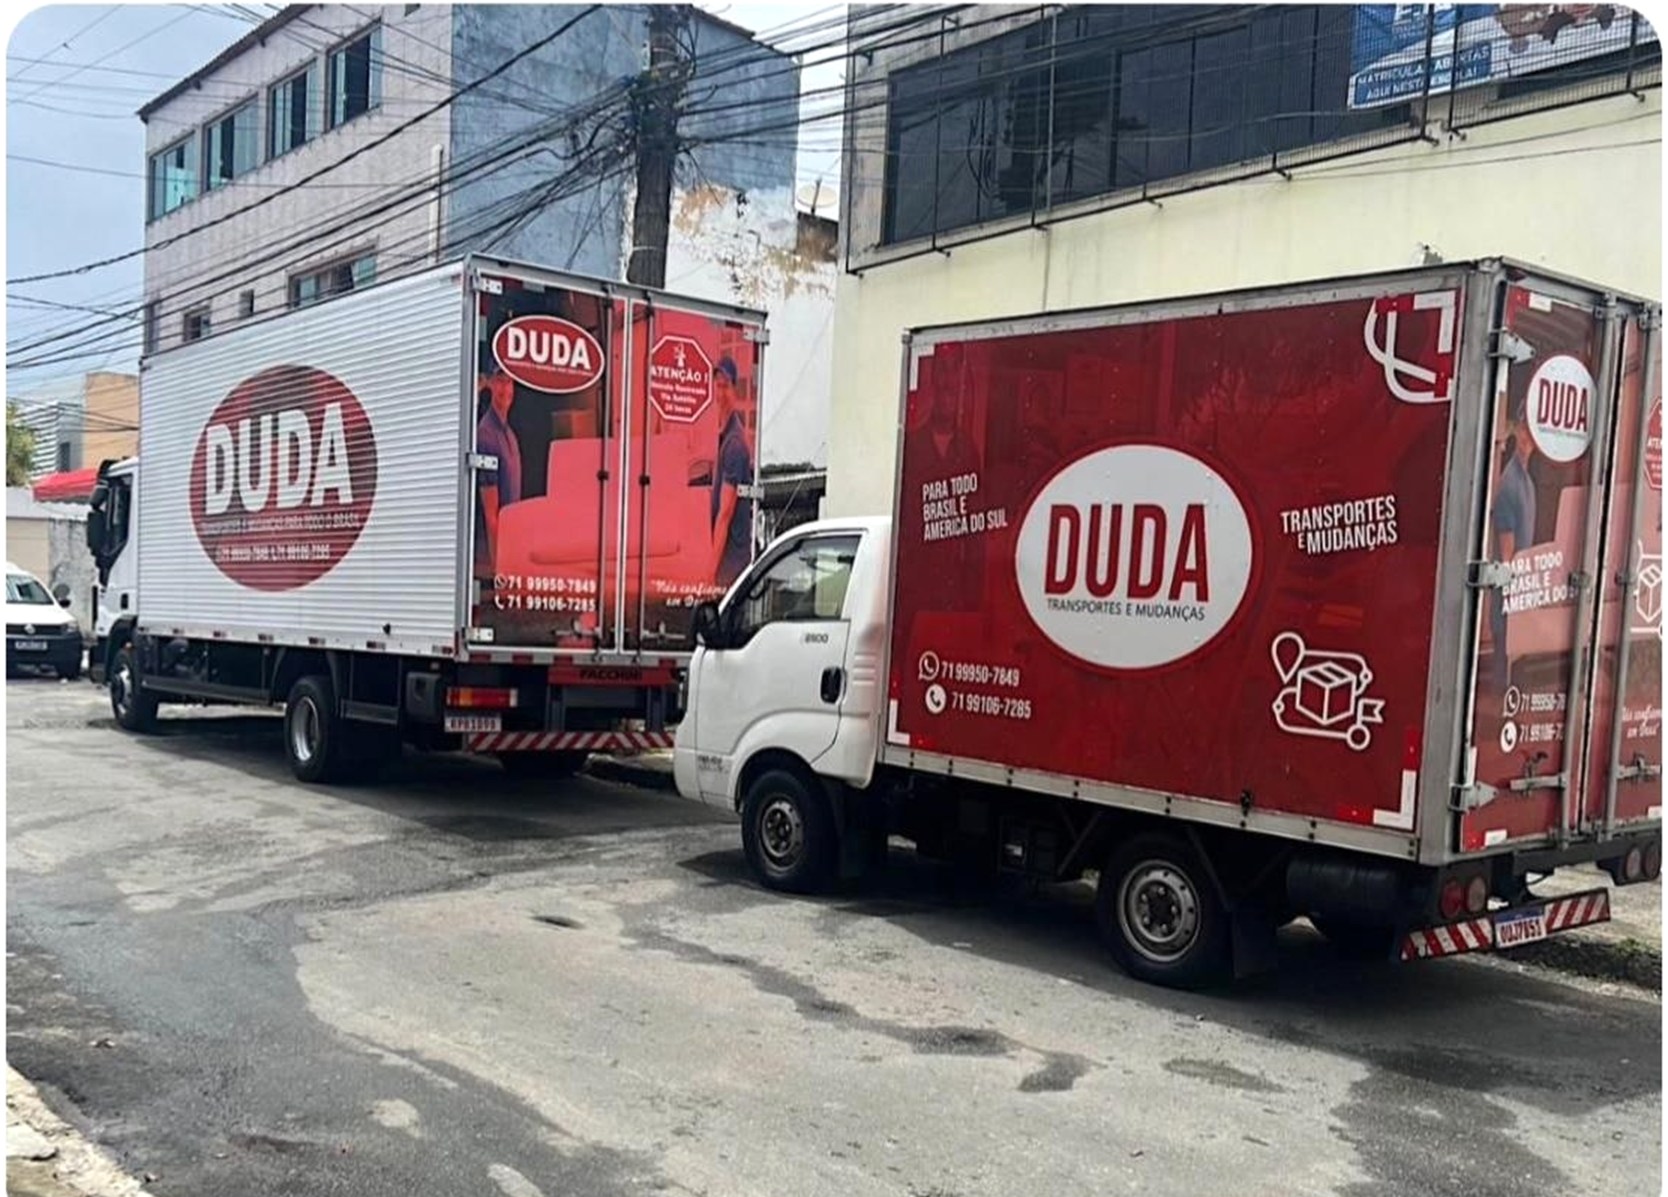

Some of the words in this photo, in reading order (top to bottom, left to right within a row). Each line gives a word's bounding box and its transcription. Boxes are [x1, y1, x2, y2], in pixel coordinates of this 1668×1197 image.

[1434, 46, 1490, 71] ABRTAS
[508, 327, 592, 370] DUDA
[1537, 378, 1588, 433] DUDA
[205, 402, 353, 515] DUDA
[923, 481, 949, 502] PARA
[950, 472, 978, 496] TODO
[923, 498, 959, 522] BRASIL
[959, 495, 967, 515] E
[970, 512, 985, 533] DO
[987, 508, 1008, 529] SUL
[1281, 494, 1396, 533] TRANSPORTES
[1298, 532, 1305, 549] E
[1306, 520, 1398, 555] MUDANÇAS
[1045, 503, 1209, 603] DUDA
[1533, 552, 1563, 572] TODO
[507, 575, 522, 589] 71
[526, 575, 596, 594] 99950-7849
[1543, 571, 1552, 588] E
[507, 594, 522, 609] 71
[526, 595, 596, 613] 99106-7285
[1552, 585, 1567, 603] DO
[1047, 598, 1122, 616] TRANSPORTES
[1125, 603, 1133, 616] E
[1135, 604, 1206, 622] MUDANÇAS
[942, 661, 954, 679] 71
[955, 663, 1020, 688] 99950-7849
[952, 691, 964, 710] 71
[966, 694, 1032, 719] 99106-7285
